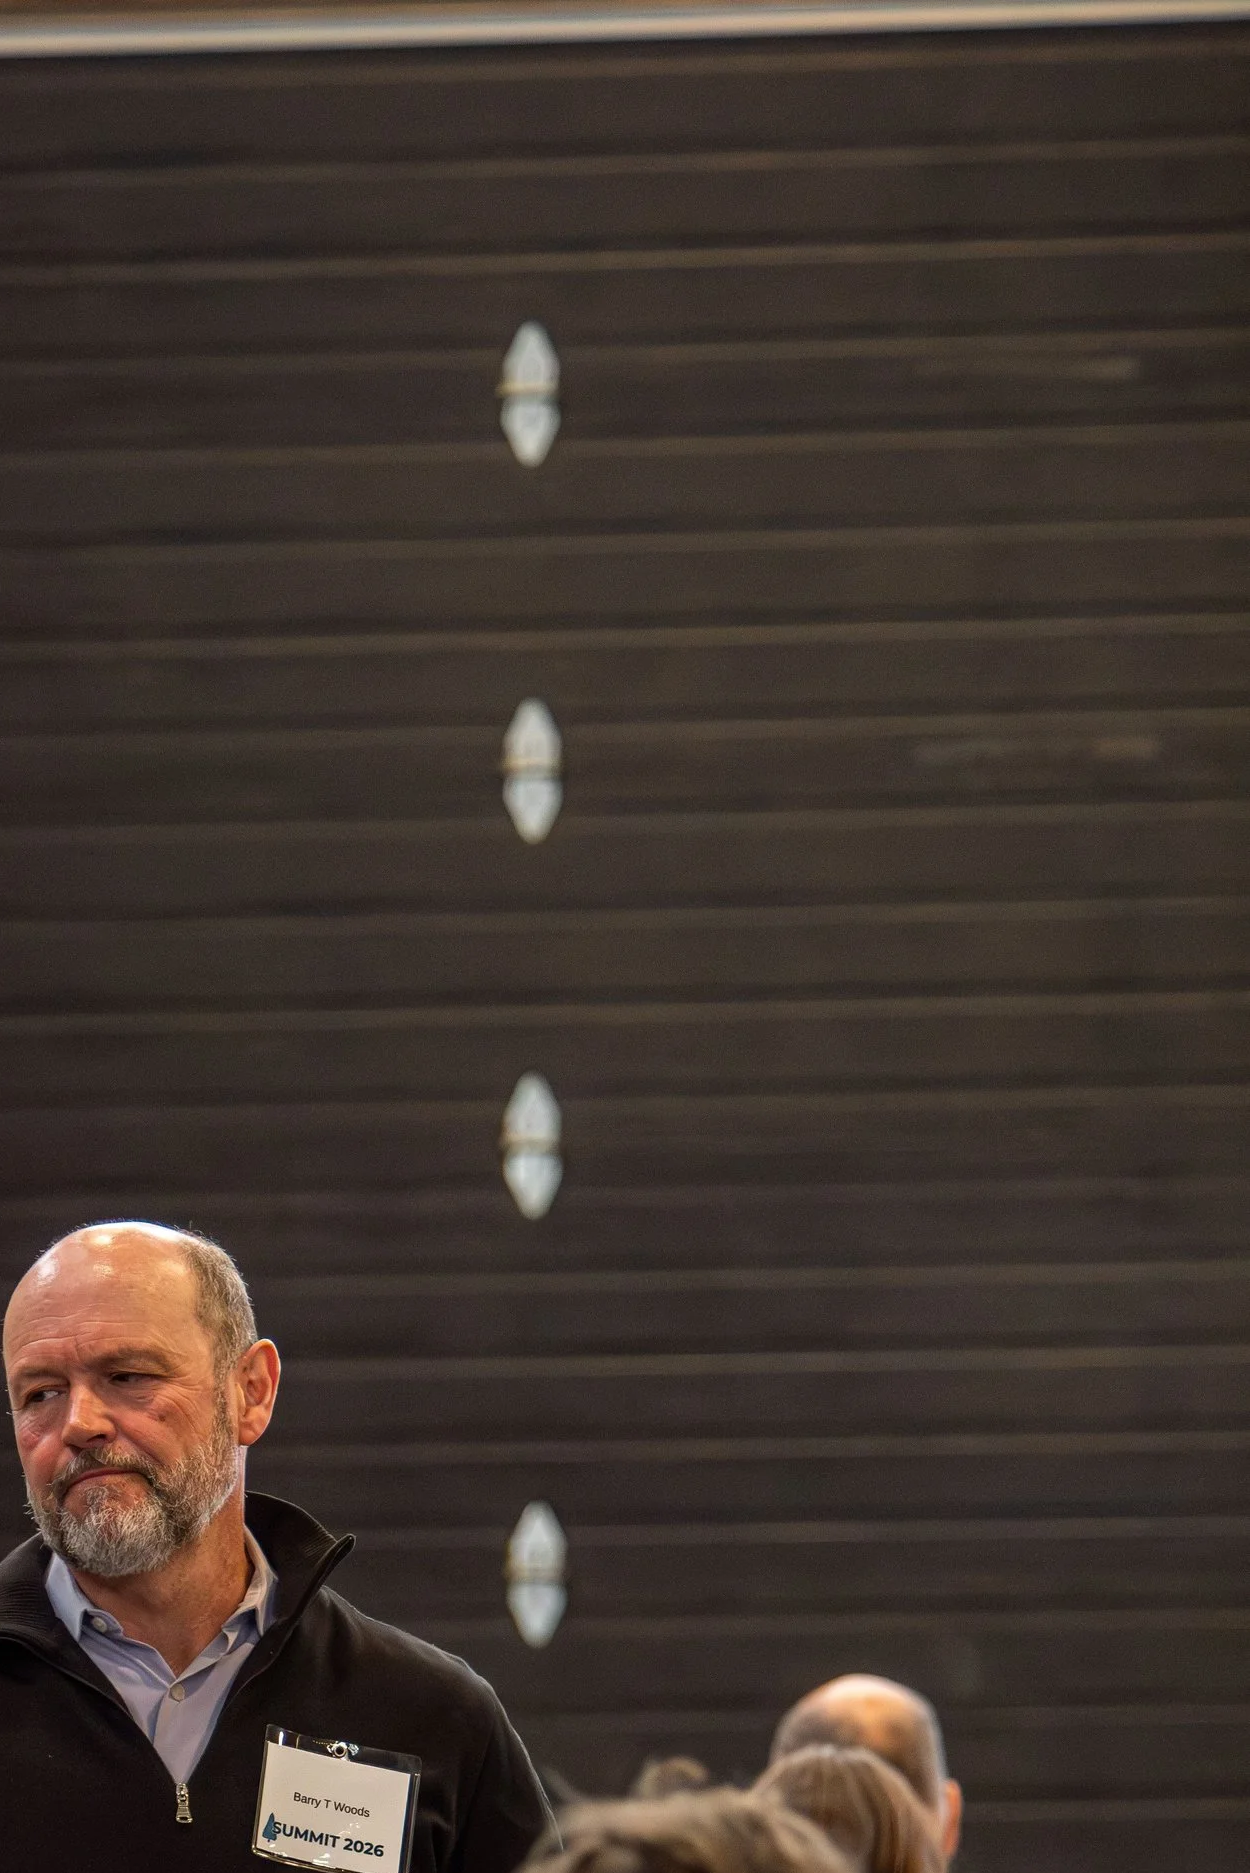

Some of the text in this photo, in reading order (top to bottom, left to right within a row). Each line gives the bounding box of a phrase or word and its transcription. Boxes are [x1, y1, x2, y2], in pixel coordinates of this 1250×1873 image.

[293, 1791, 370, 1818] Barry T Woods
[272, 1821, 384, 1857] SUMMIT 2026
